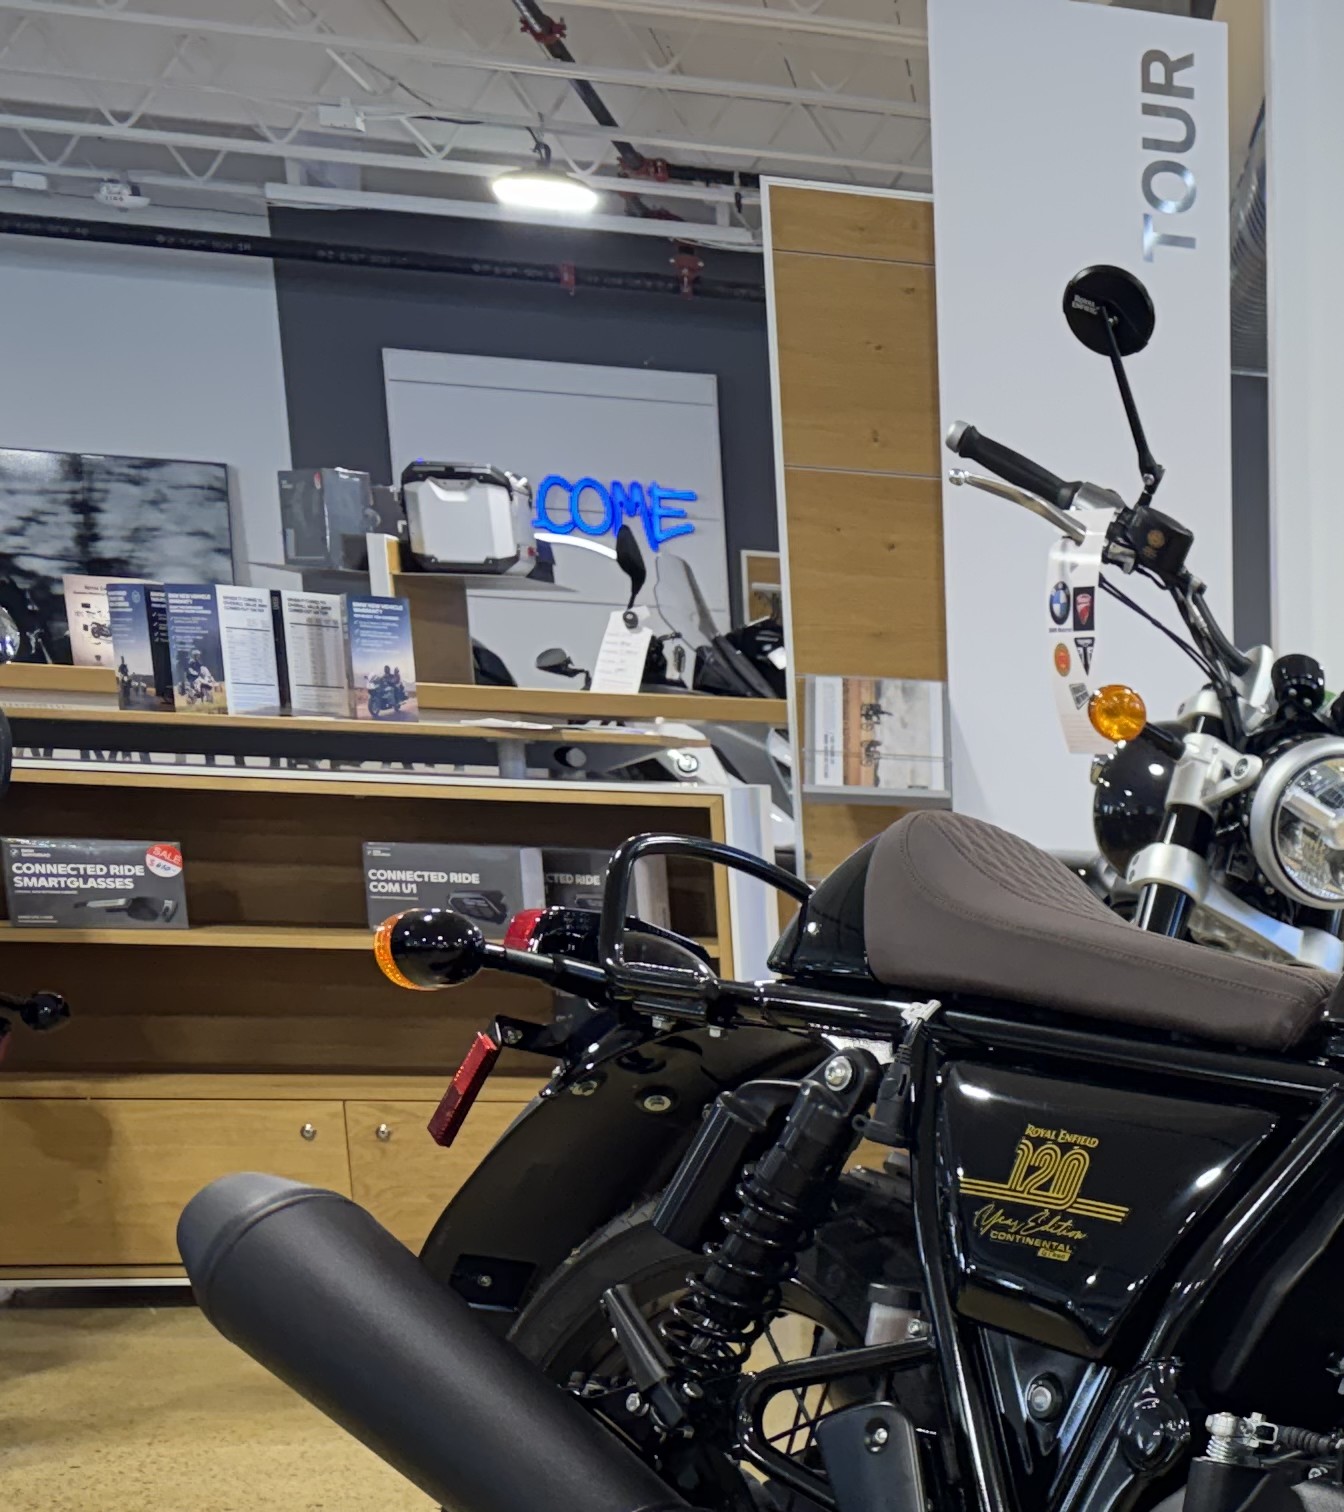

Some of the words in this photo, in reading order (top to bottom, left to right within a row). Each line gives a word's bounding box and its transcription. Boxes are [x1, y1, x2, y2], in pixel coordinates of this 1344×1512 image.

[1141, 49, 1197, 263] TOUR
[532, 475, 697, 553] COME
[152, 846, 182, 862] SALE
[11, 862, 108, 876] CONNECTED
[109, 864, 145, 876] RIDE
[368, 868, 448, 883] CONNECTED
[449, 872, 480, 884] RIDE
[13, 877, 135, 890] SMARTGLASSES
[369, 881, 400, 893] COM
[402, 882, 418, 894] U1
[575, 874, 600, 886] RIDE
[1024, 1123, 1057, 1141] ROYAL
[1058, 1129, 1099, 1149] ENFIELD
[1007, 1137, 1091, 1211] 120
[1019, 1209, 1088, 1239] Edition
[989, 1229, 1074, 1254] CONTINENTAL
